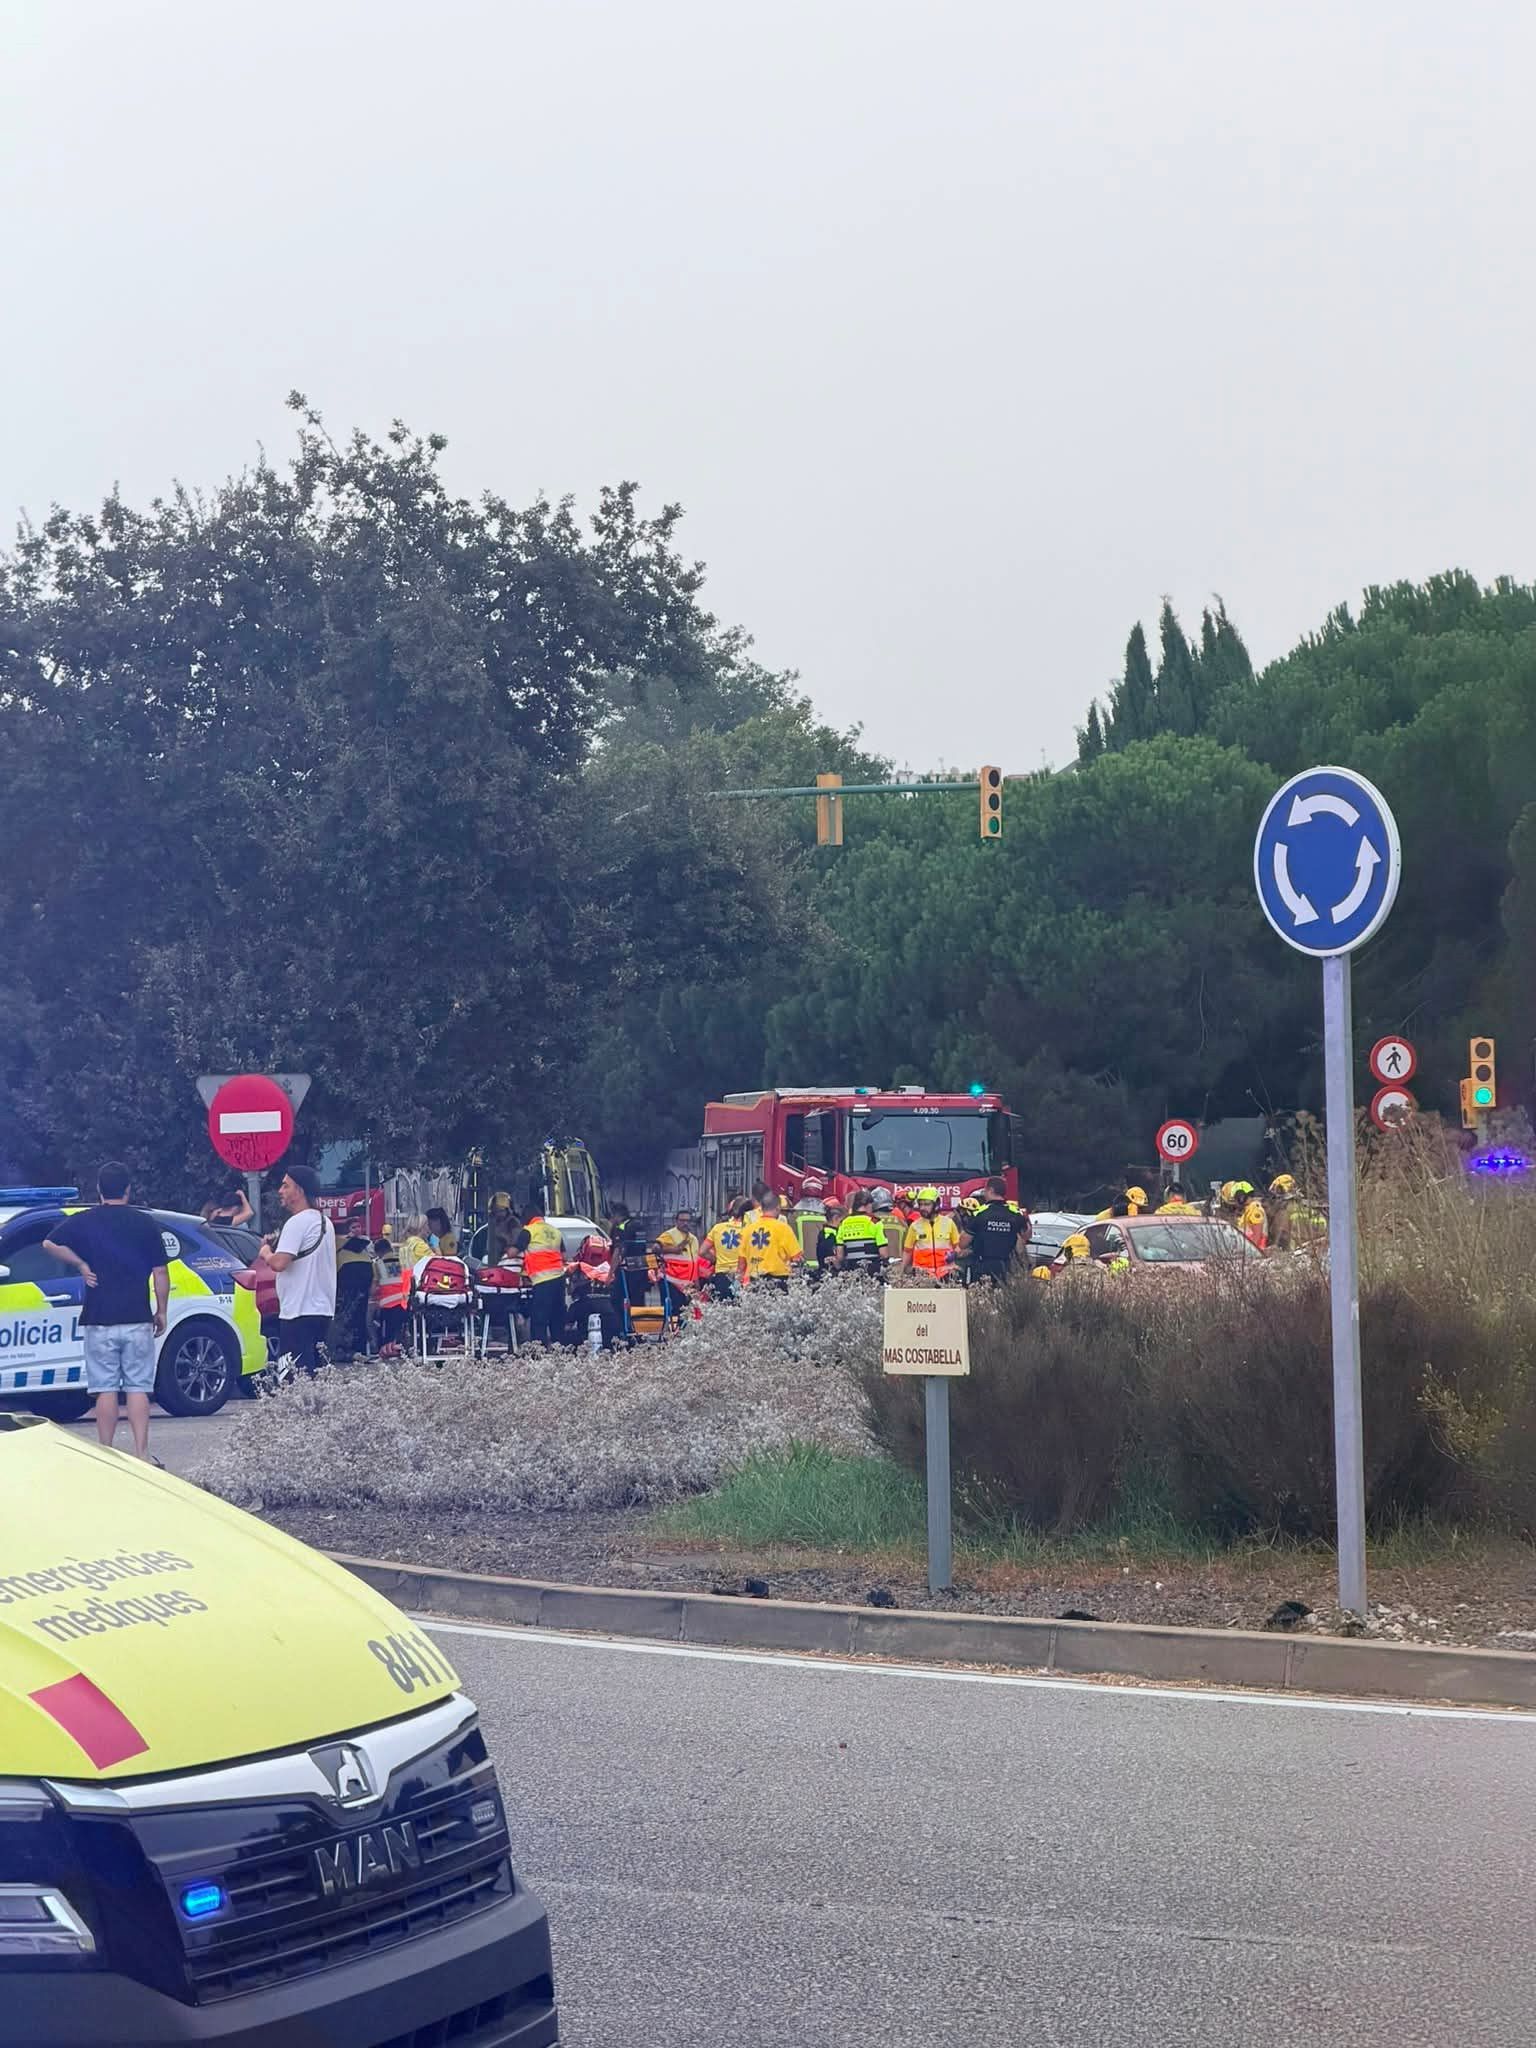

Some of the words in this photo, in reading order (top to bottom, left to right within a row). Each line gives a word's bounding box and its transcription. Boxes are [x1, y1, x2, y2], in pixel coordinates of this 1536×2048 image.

[913, 1107, 940, 1115] 4.09.30
[1167, 1134, 1187, 1148] 60
[906, 1300, 937, 1313] Rotonda
[915, 1324, 928, 1337] del
[884, 1347, 904, 1364] MAS
[905, 1348, 962, 1365] COSTABELLA
[367, 1631, 455, 1694] 8411
[314, 1821, 422, 1896] MAN
